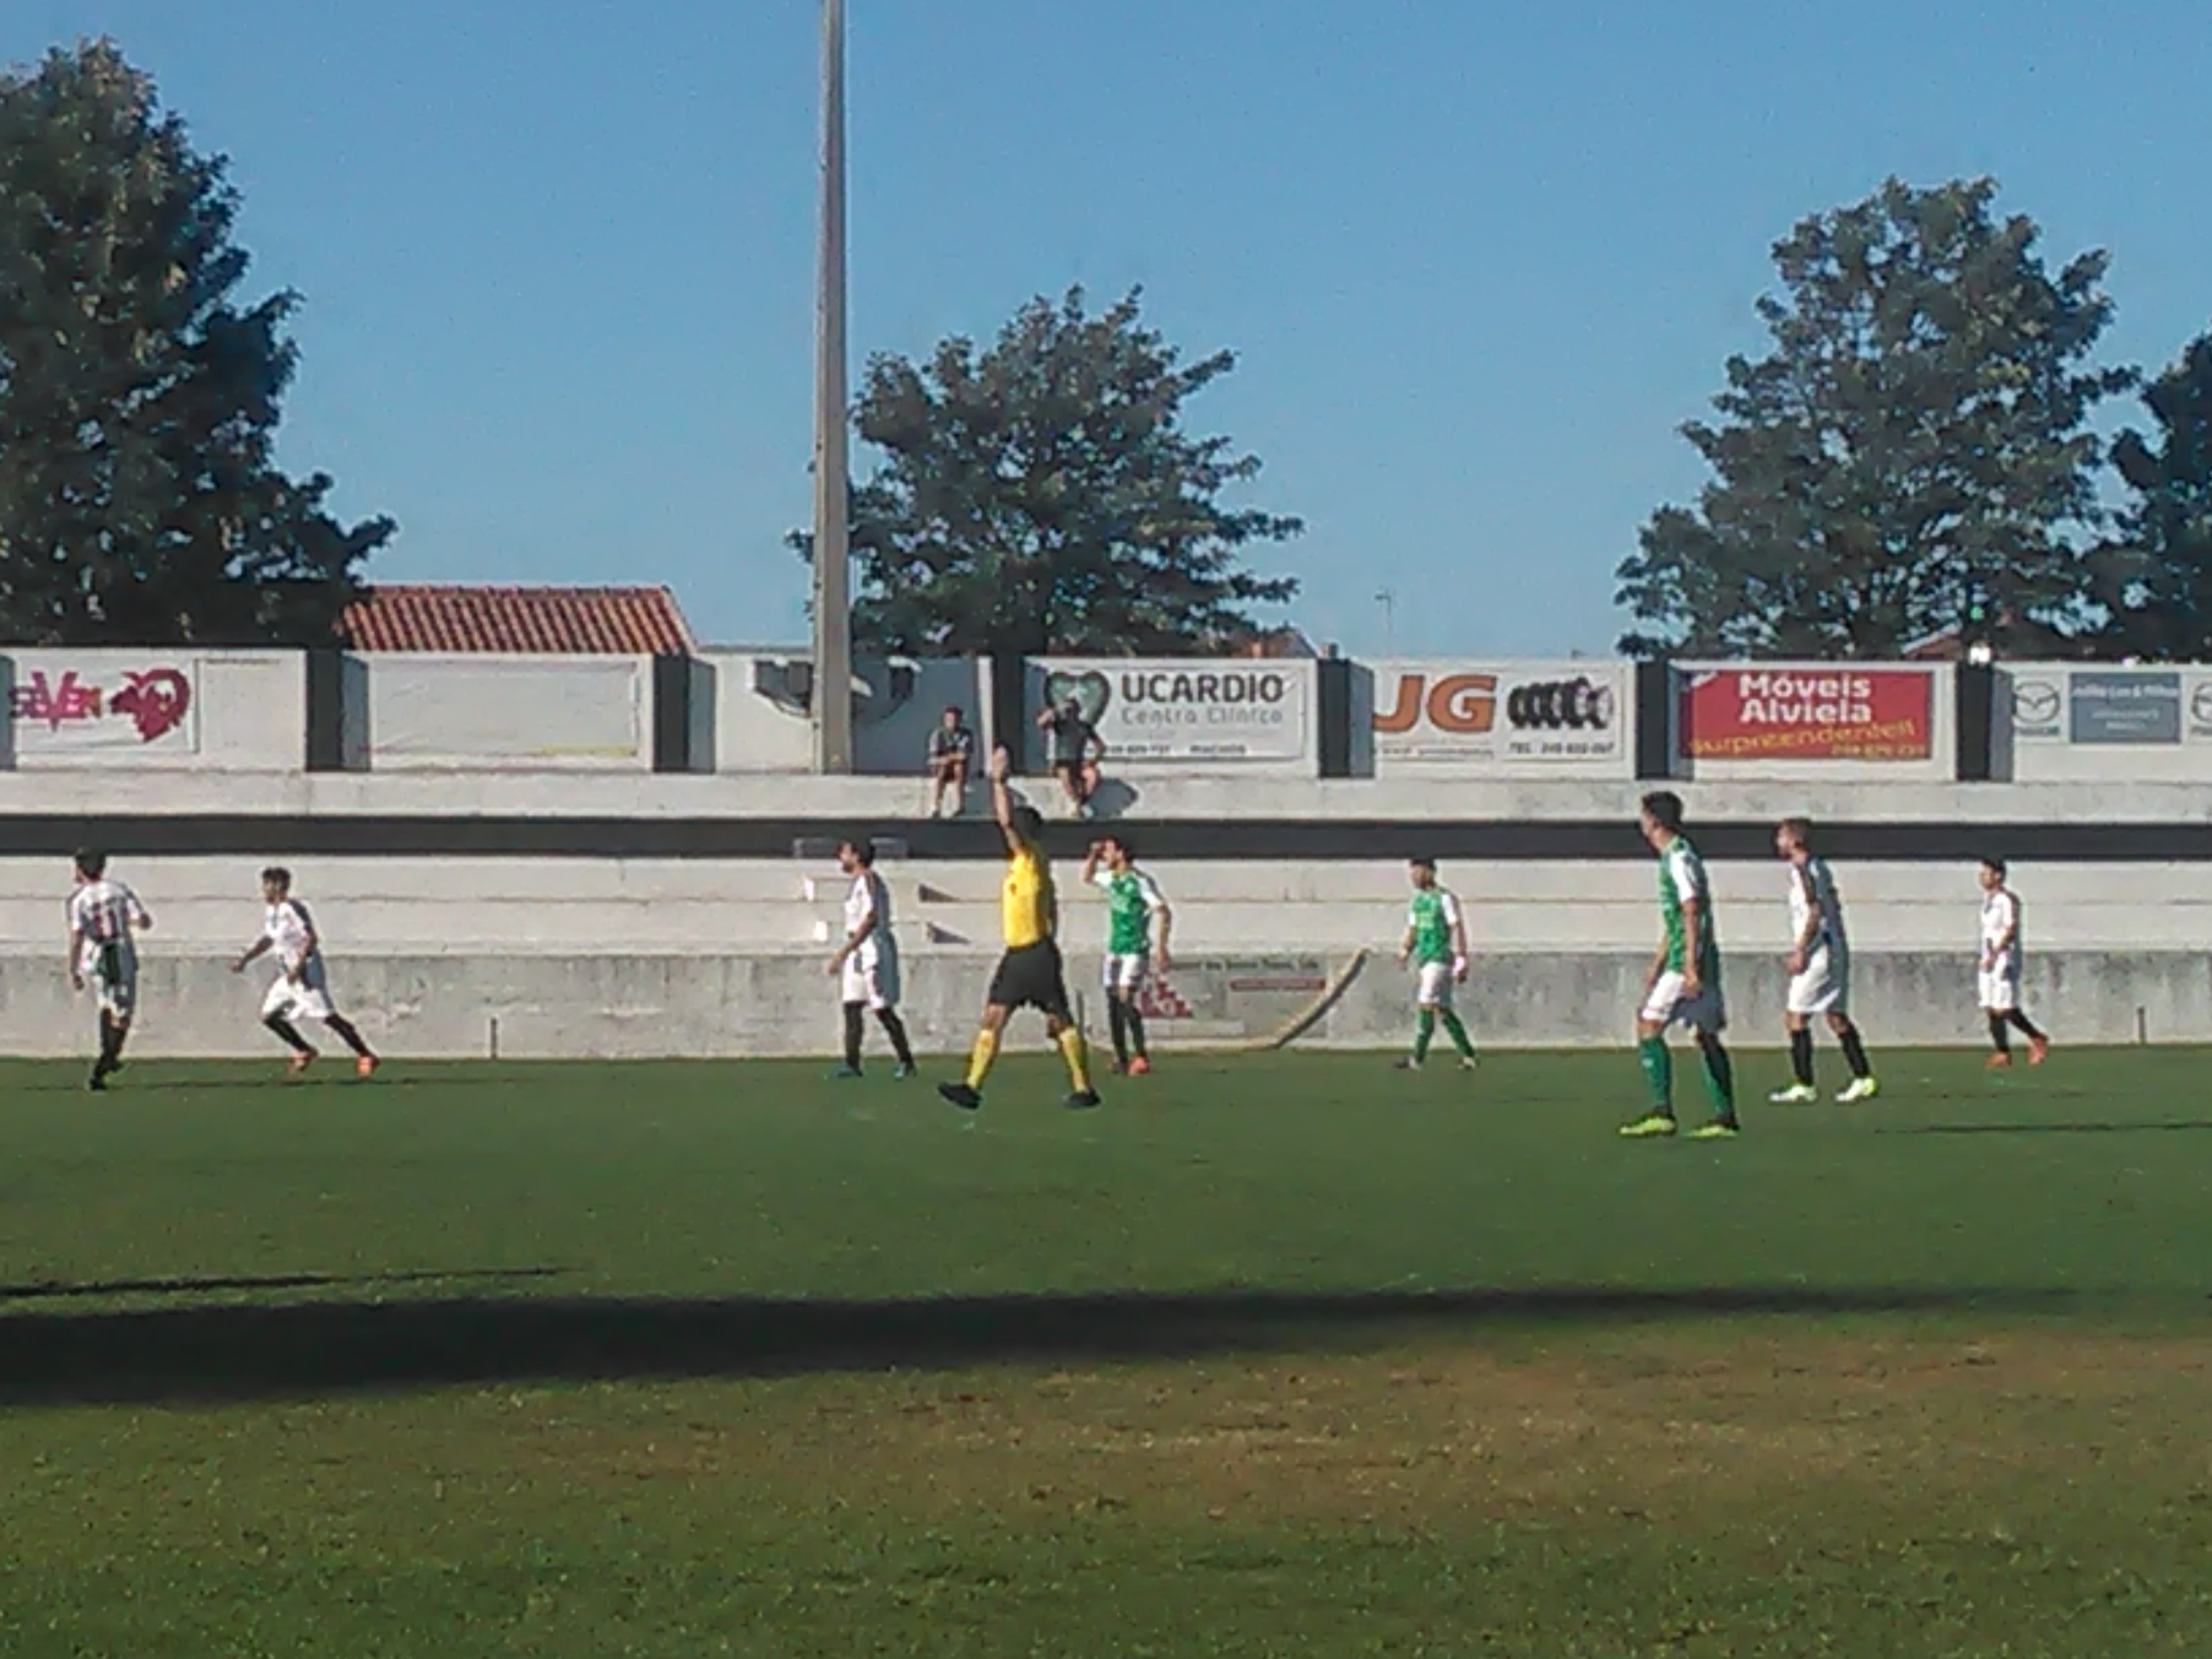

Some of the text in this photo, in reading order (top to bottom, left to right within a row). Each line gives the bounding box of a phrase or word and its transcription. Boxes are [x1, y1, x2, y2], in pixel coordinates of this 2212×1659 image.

[1122, 675, 1284, 703] UCARDIO
[1739, 673, 1872, 697] Móveis
[1122, 708, 1197, 724] Centro
[1372, 674, 1496, 732] JG
[1739, 697, 1872, 723] Alviela
